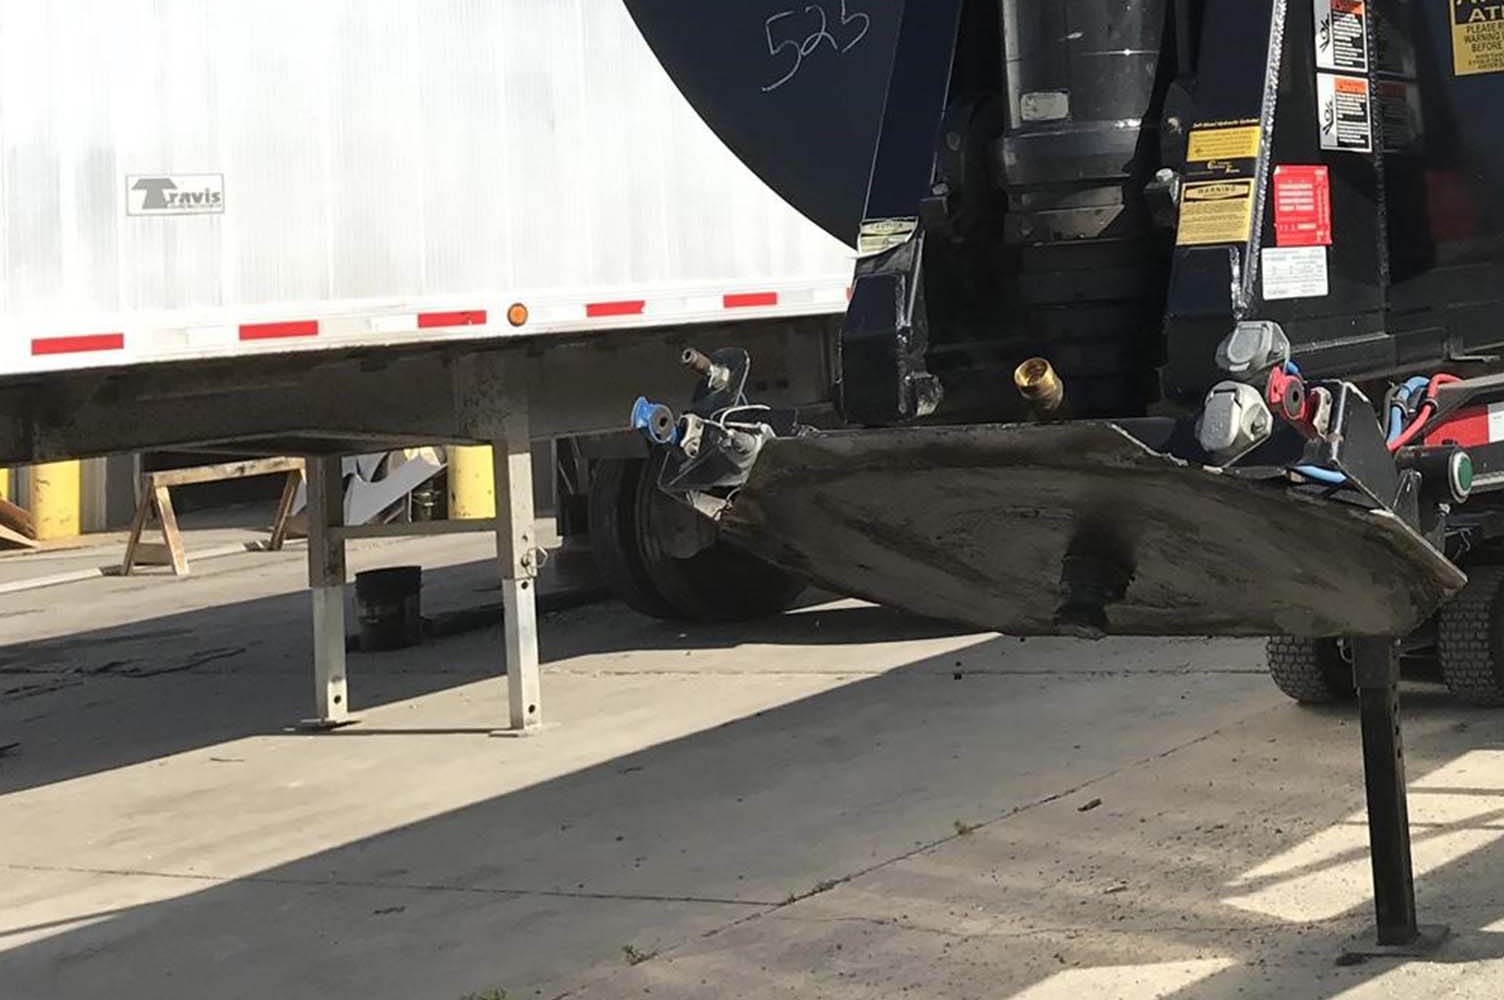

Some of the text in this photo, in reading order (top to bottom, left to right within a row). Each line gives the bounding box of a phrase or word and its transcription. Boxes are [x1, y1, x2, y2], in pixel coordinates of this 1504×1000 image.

[1466, 22, 1496, 33] PLEASE
[1463, 31, 1499, 43] WARNING
[1471, 40, 1503, 52] BEFORE
[131, 178, 221, 209] Travis
